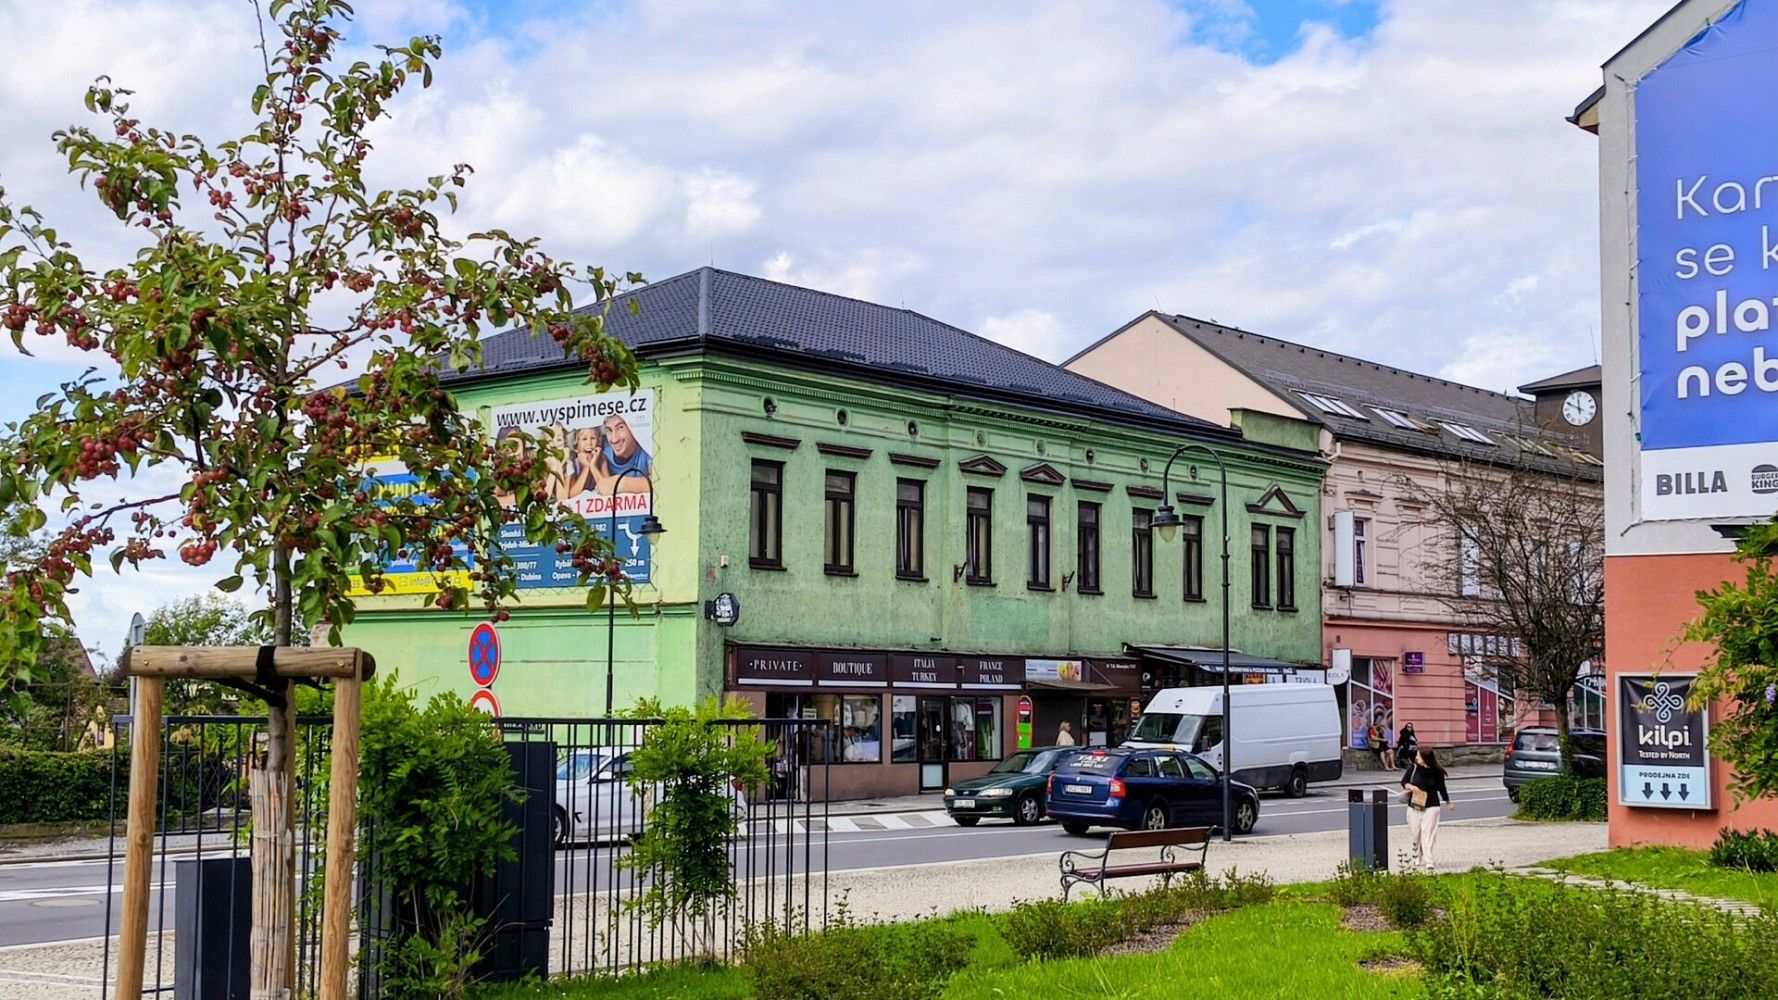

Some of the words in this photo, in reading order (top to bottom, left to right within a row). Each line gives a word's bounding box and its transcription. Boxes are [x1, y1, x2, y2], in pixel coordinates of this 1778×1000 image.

[1676, 175, 1778, 220] Kar
[1675, 243, 1735, 280] se
[1676, 289, 1778, 352] pla
[496, 398, 647, 428] www.vyspimese.cz
[1656, 470, 1728, 496] BILLA
[586, 494, 647, 513] ZDARMA
[754, 659, 799, 672] PRIVATE
[832, 661, 873, 676] BOUTIQUE
[913, 658, 936, 669] ITALIA
[979, 660, 1003, 671] FRANCE
[911, 671, 938, 682] TURKEY
[979, 673, 1003, 684] POLAND
[1638, 724, 1691, 750] kilpi
[1639, 771, 1676, 779] PRODEJNA
[1677, 772, 1691, 780] ZDE
